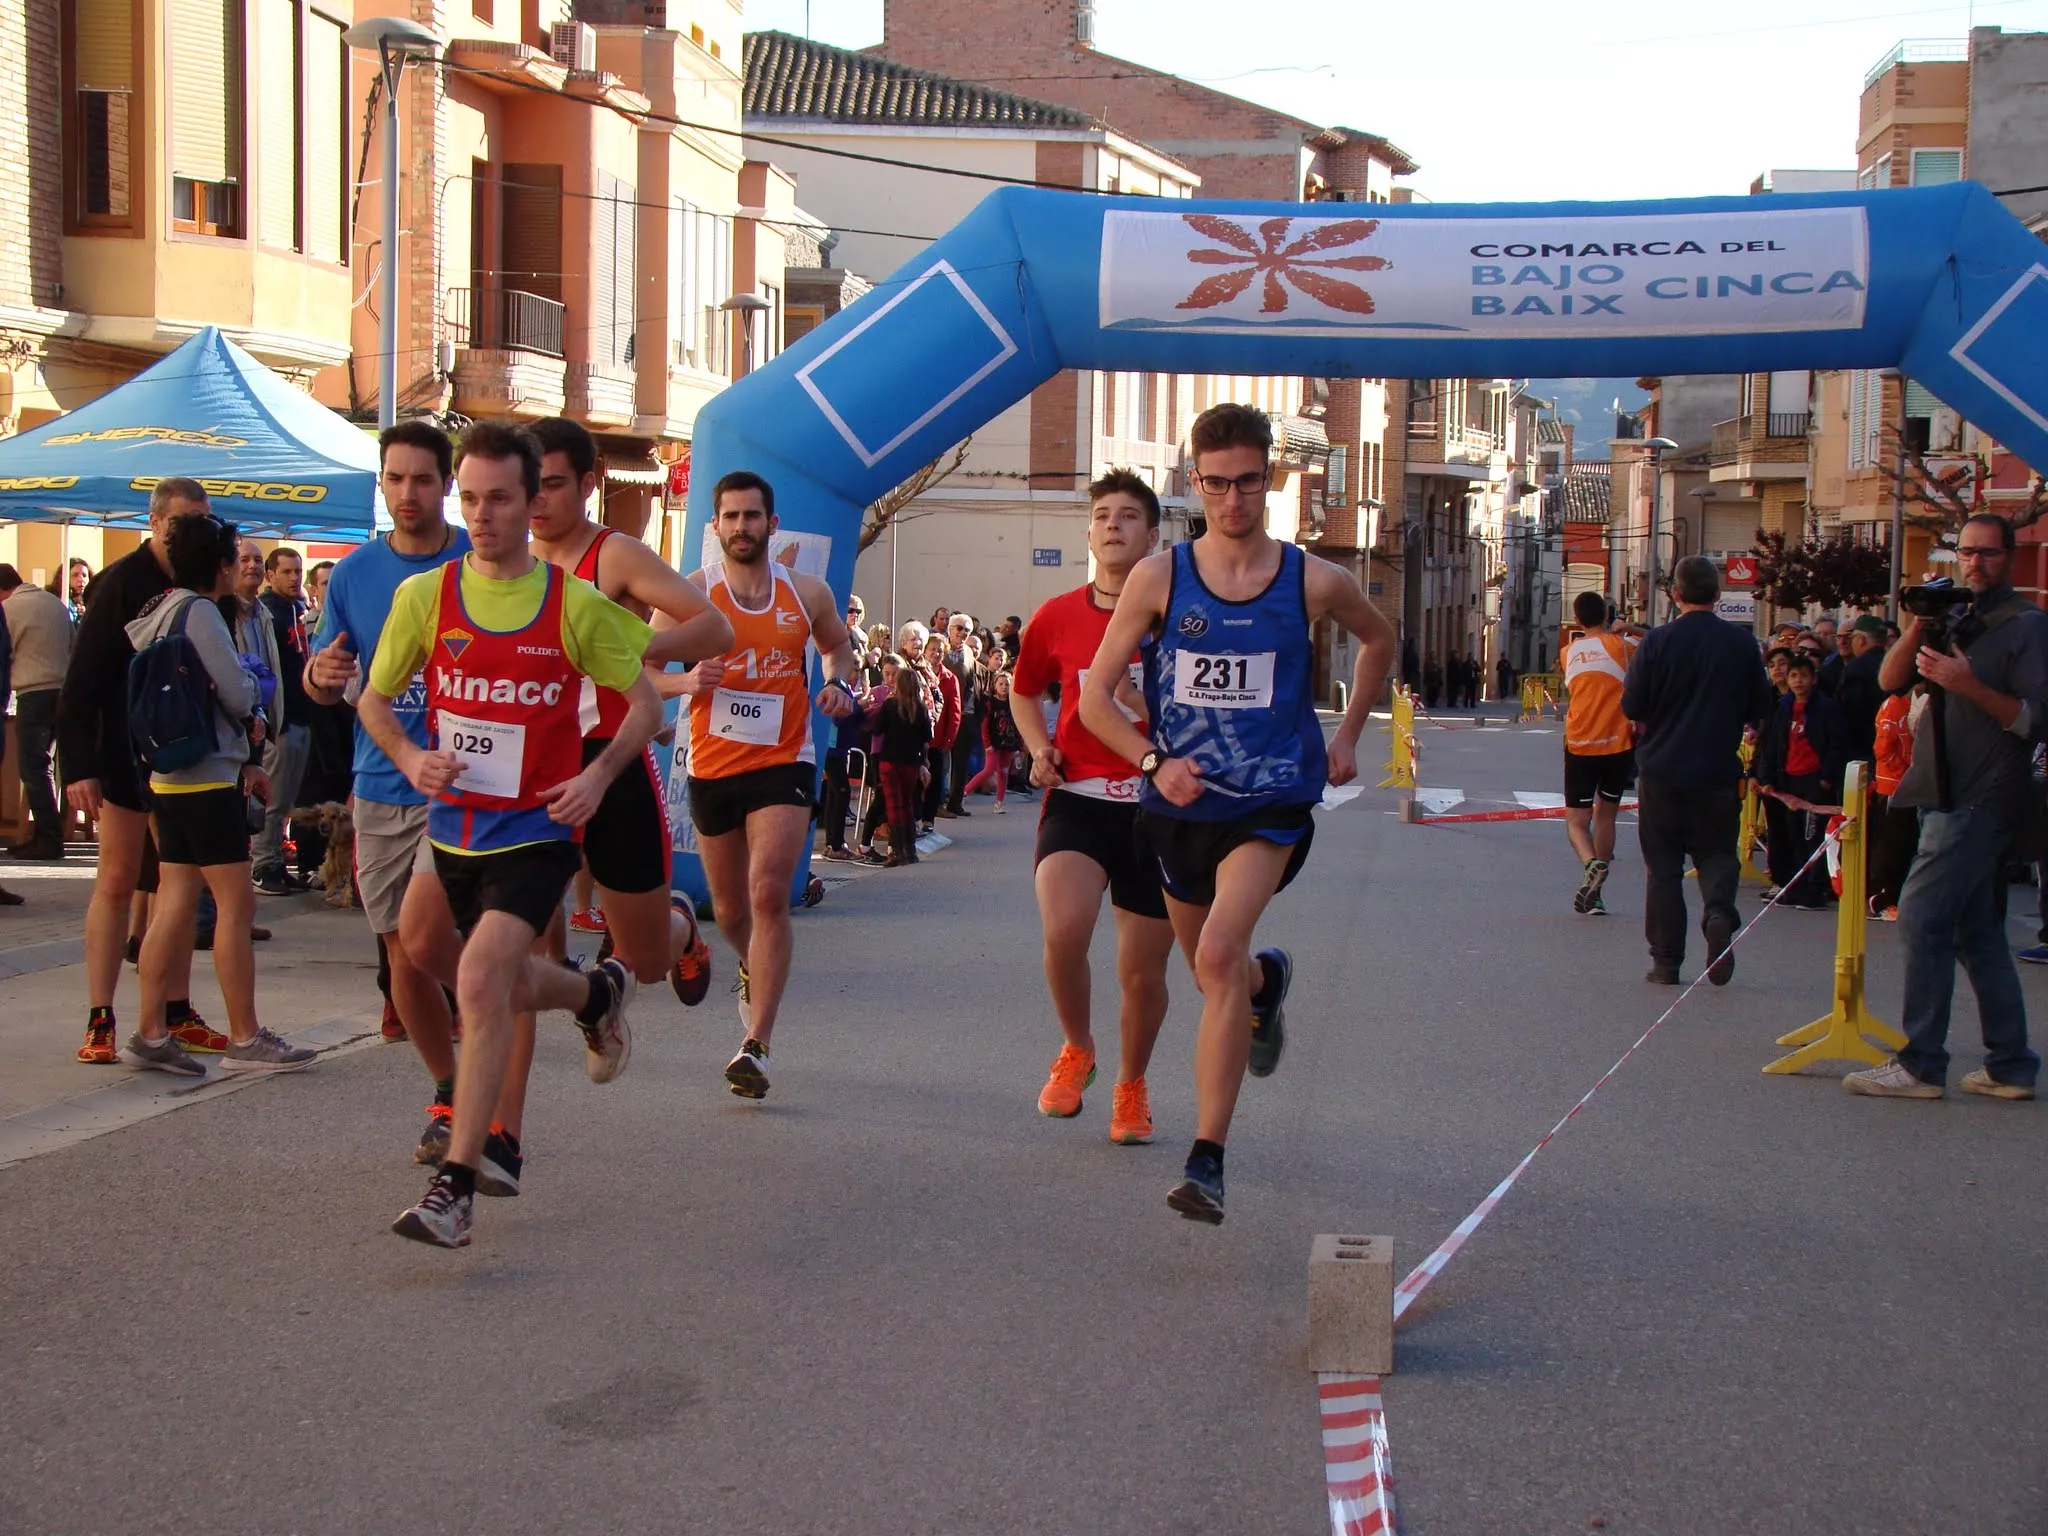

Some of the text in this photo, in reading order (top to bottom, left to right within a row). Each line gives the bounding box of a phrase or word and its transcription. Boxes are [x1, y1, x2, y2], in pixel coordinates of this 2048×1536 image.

[1470, 240, 1786, 257] COMARCA DEL
[1471, 264, 1864, 299] BAJO CINCA
[1471, 294, 1624, 316] BAIX
[40, 426, 250, 447] SHERCO
[129, 476, 329, 503] SERCO
[1720, 603, 1746, 613] Cada
[1178, 617, 1204, 632] 30
[516, 646, 560, 656] POLIDUX
[1193, 657, 1248, 690] 231
[1238, 693, 1257, 701] Cinca
[730, 702, 761, 719] 006
[453, 732, 494, 755] 029
